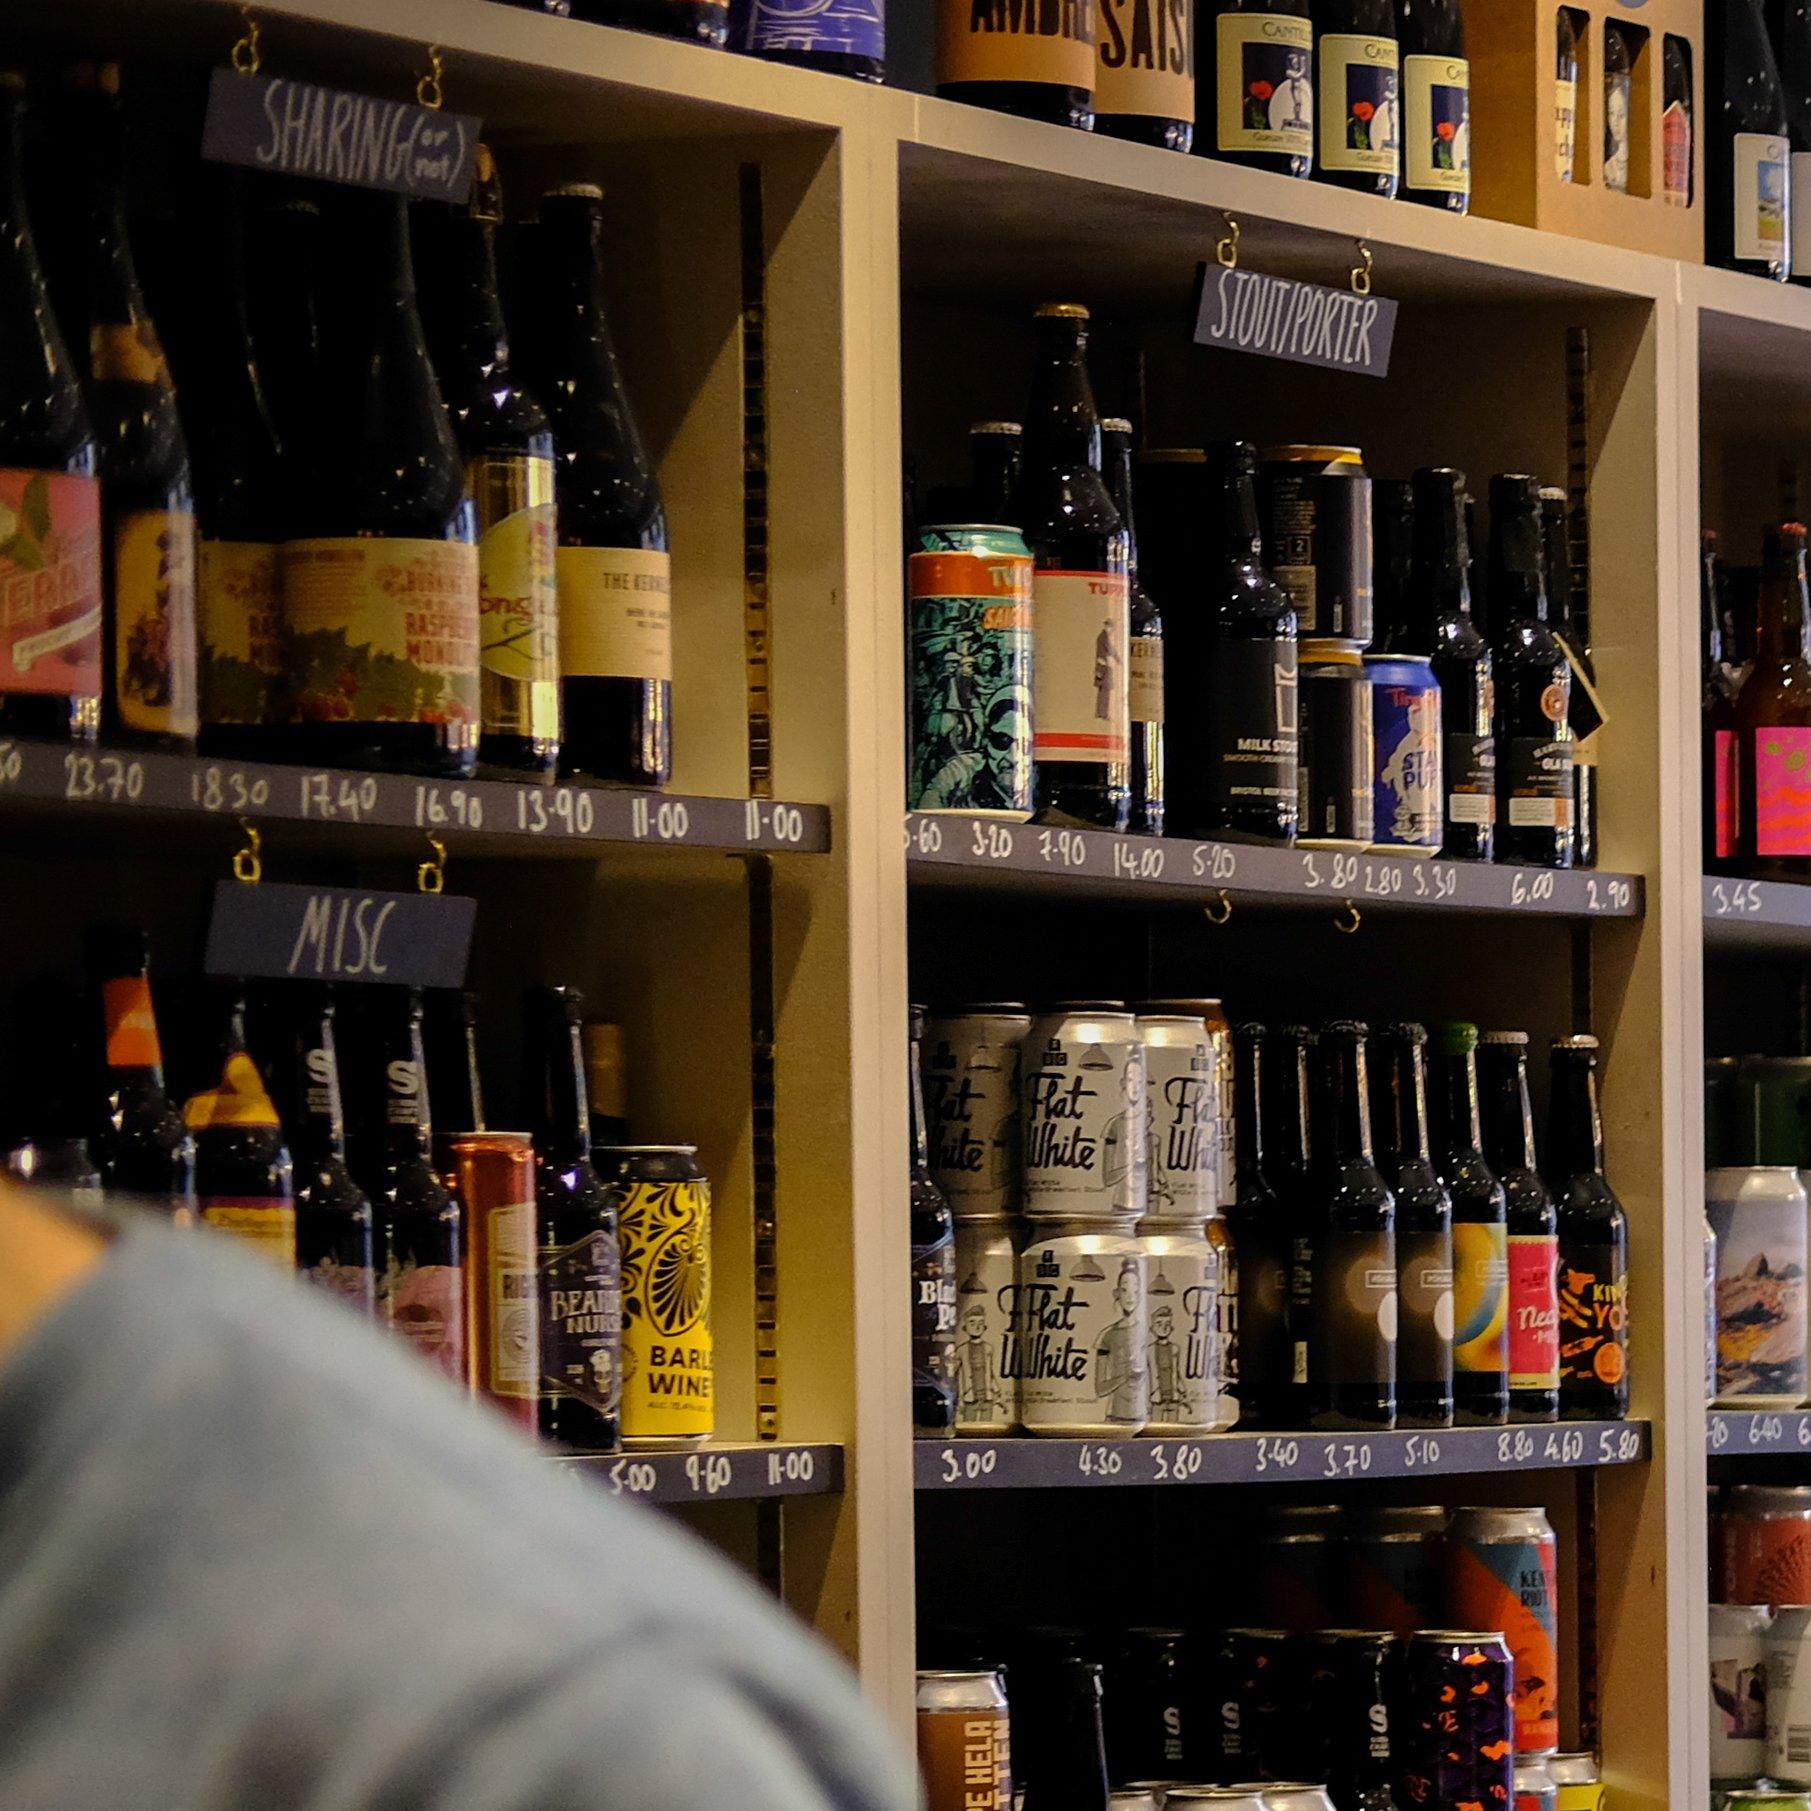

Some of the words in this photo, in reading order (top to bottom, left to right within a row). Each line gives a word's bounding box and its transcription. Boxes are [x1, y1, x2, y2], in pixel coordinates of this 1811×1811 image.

[1211, 267, 1378, 366] STOUT/PORTER
[287, 895, 397, 975] MISC
[1026, 1072, 1098, 1122] Flat
[1025, 1121, 1097, 1171] White
[1021, 1283, 1089, 1333] Flat
[1021, 1332, 1088, 1381] White
[964, 1719, 991, 1785] HELA
